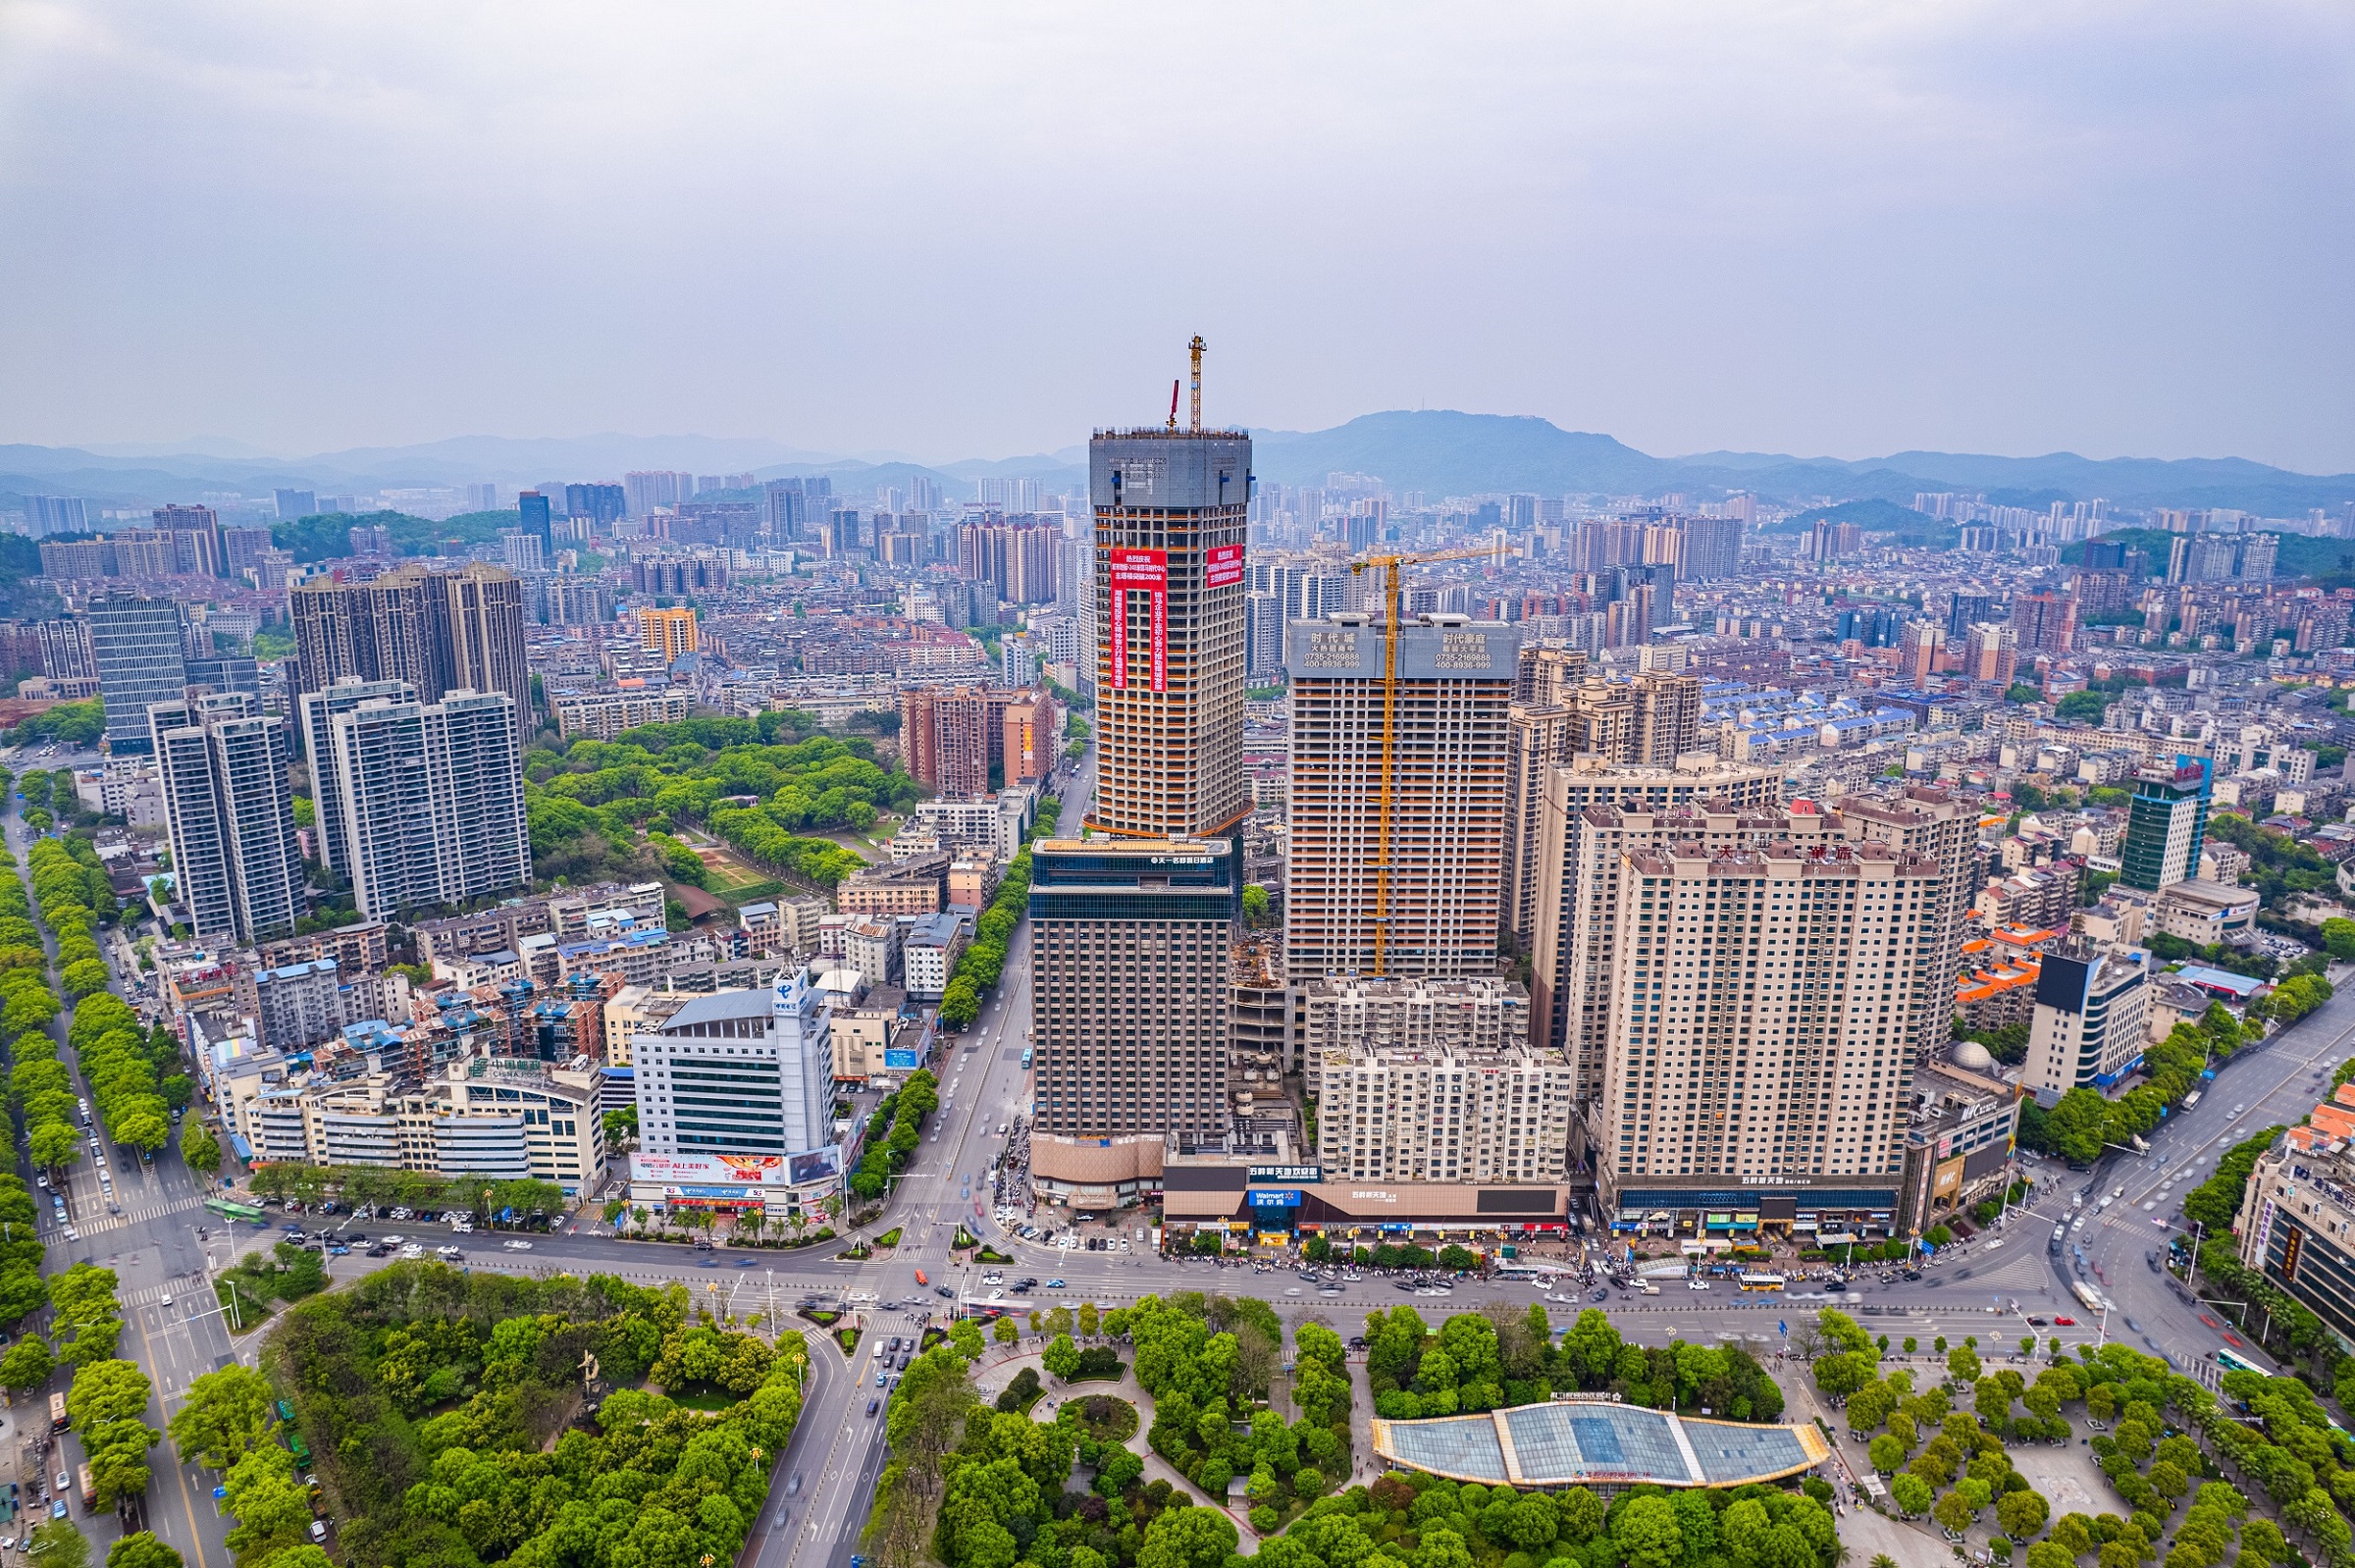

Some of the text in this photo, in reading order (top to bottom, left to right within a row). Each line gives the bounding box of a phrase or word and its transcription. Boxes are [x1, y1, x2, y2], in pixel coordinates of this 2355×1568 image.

[1311, 633, 1355, 643] 时代城
[1443, 633, 1486, 644] 时代豪庭
[492, 1060, 541, 1071] 中国邮政
